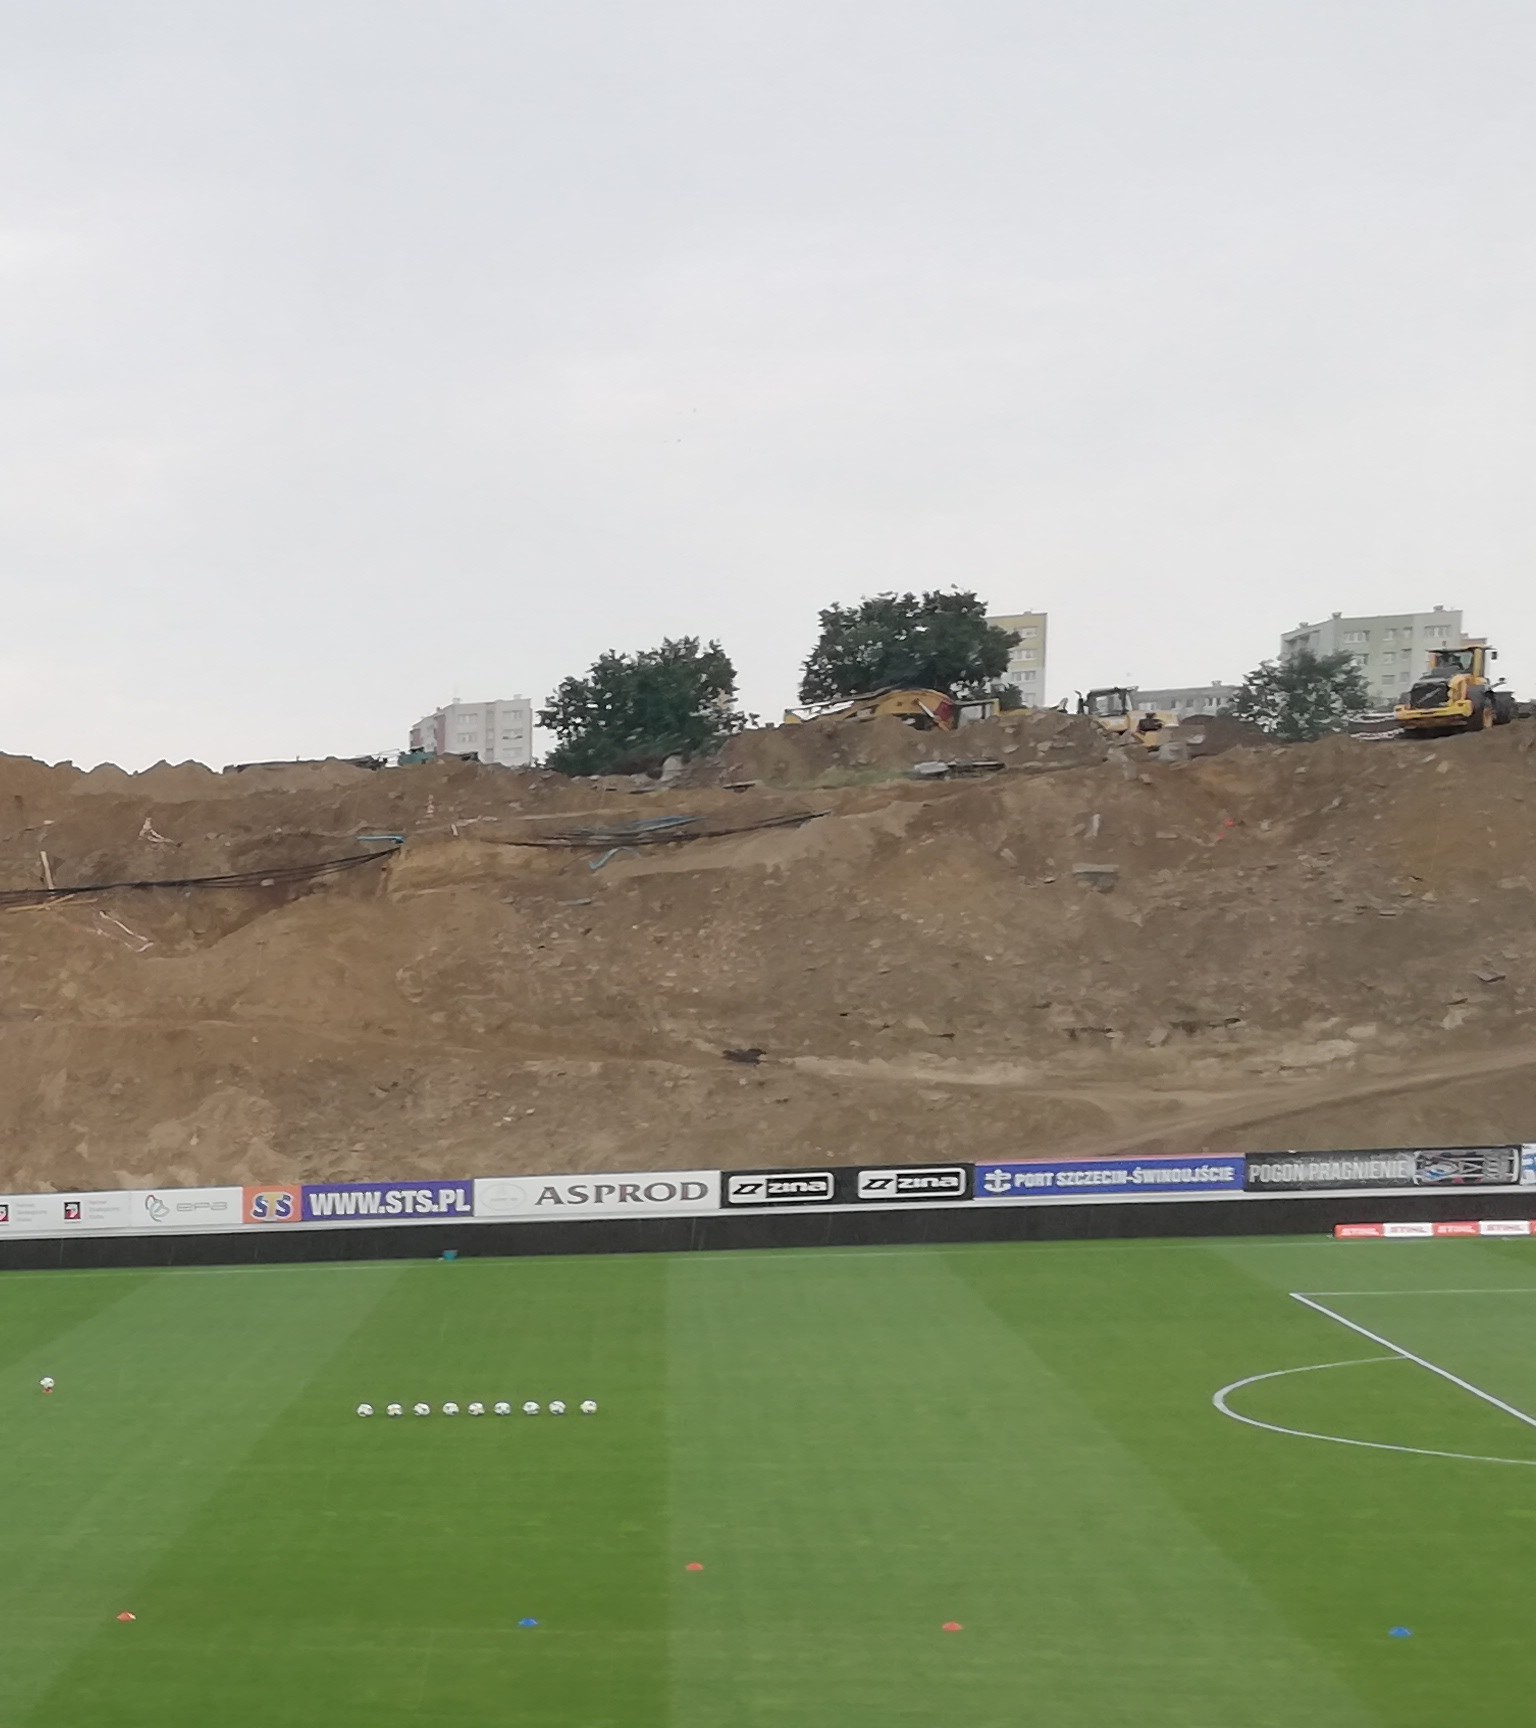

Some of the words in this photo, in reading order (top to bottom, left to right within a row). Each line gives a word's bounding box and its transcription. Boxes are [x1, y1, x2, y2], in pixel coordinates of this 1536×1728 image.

[768, 1179, 827, 1195] zina
[896, 1175, 959, 1189] zina
[1014, 1172, 1054, 1188] PORT
[1056, 1166, 1234, 1188] SZCZECIN-ŚWINOUJŚCIE
[252, 1193, 293, 1219] STS
[308, 1188, 471, 1216] WWW.STS.PL
[535, 1181, 710, 1207] ASPROD
